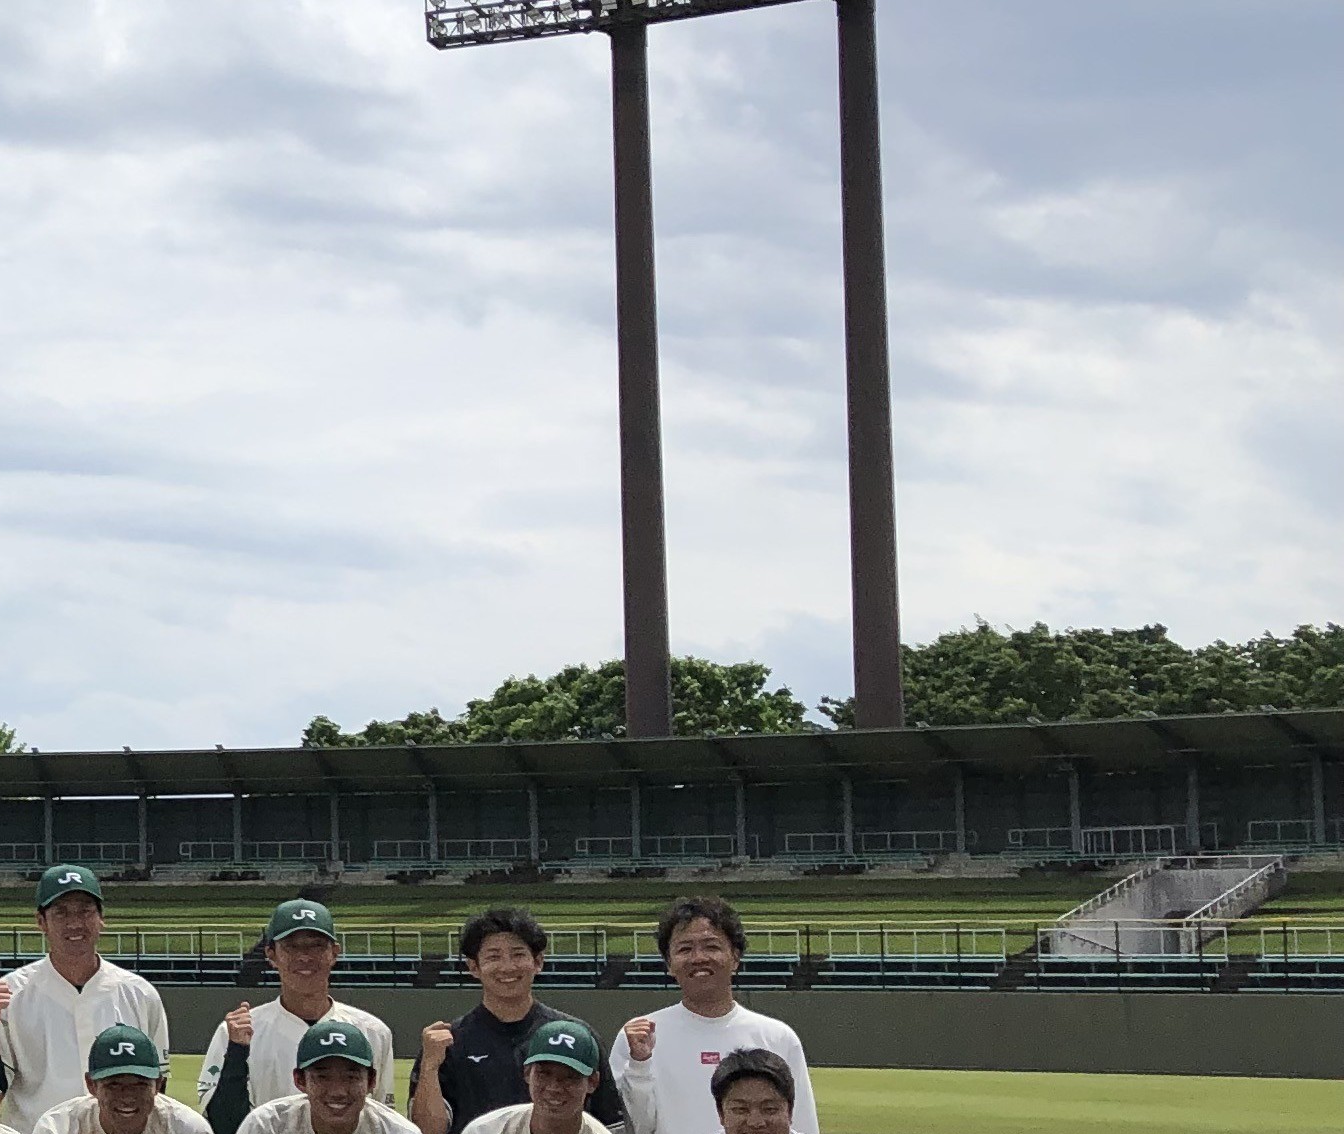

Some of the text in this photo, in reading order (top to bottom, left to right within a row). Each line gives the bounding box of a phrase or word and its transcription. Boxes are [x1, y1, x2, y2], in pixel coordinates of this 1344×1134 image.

[57, 871, 84, 885] JR
[292, 909, 317, 921] JR
[320, 1032, 347, 1046] JR
[548, 1033, 576, 1050] JR
[109, 1042, 136, 1056] JR
